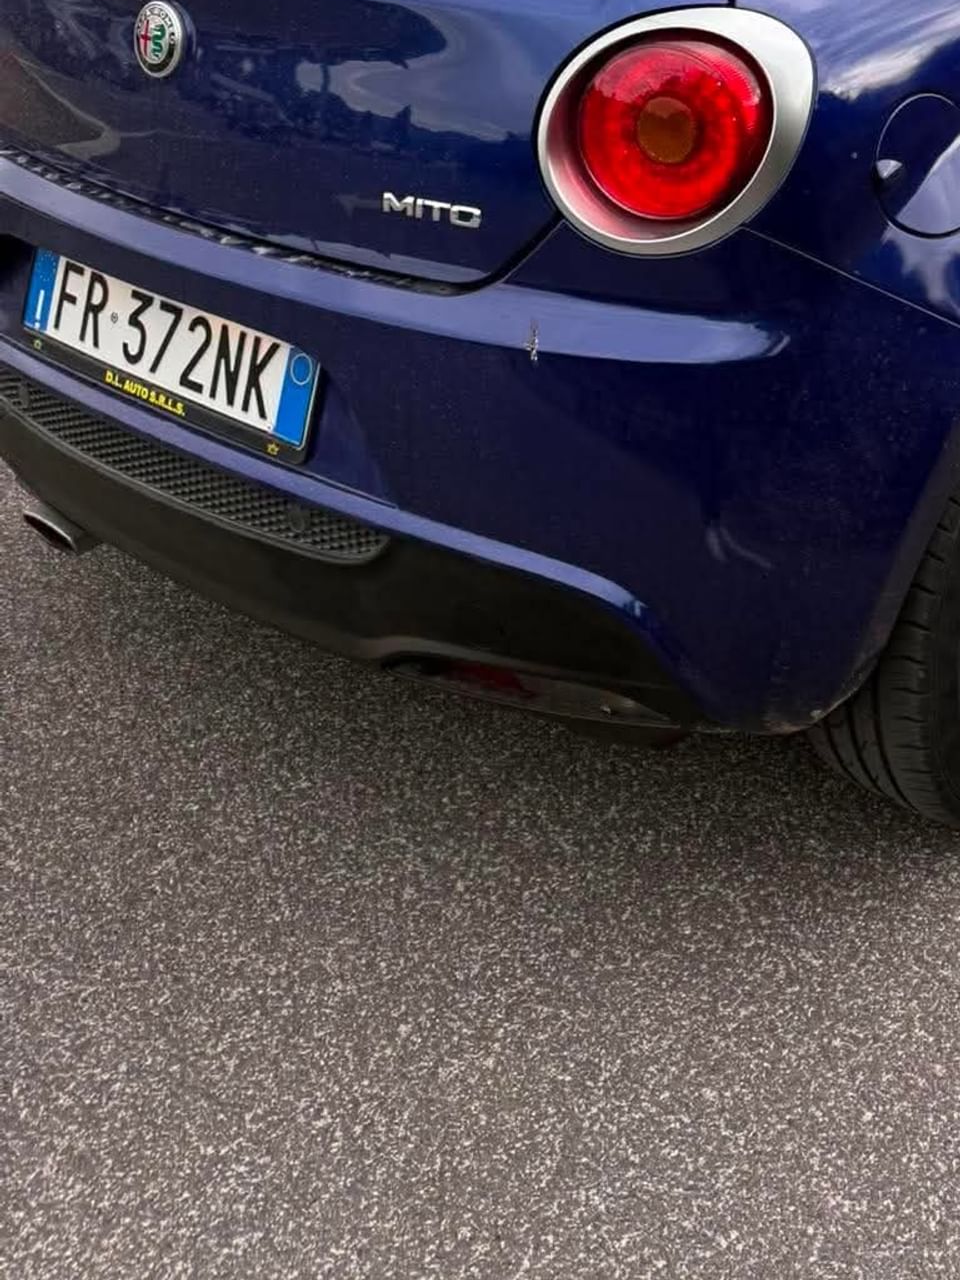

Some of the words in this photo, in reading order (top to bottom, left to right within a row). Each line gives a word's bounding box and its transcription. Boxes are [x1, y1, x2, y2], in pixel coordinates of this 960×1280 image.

[383, 191, 481, 228] MITO
[53, 260, 109, 349] FR
[122, 289, 281, 421] 372NK
[105, 369, 122, 389] D.L.
[123, 379, 148, 400] AUTO
[149, 390, 185, 417] S.R.L.S.
